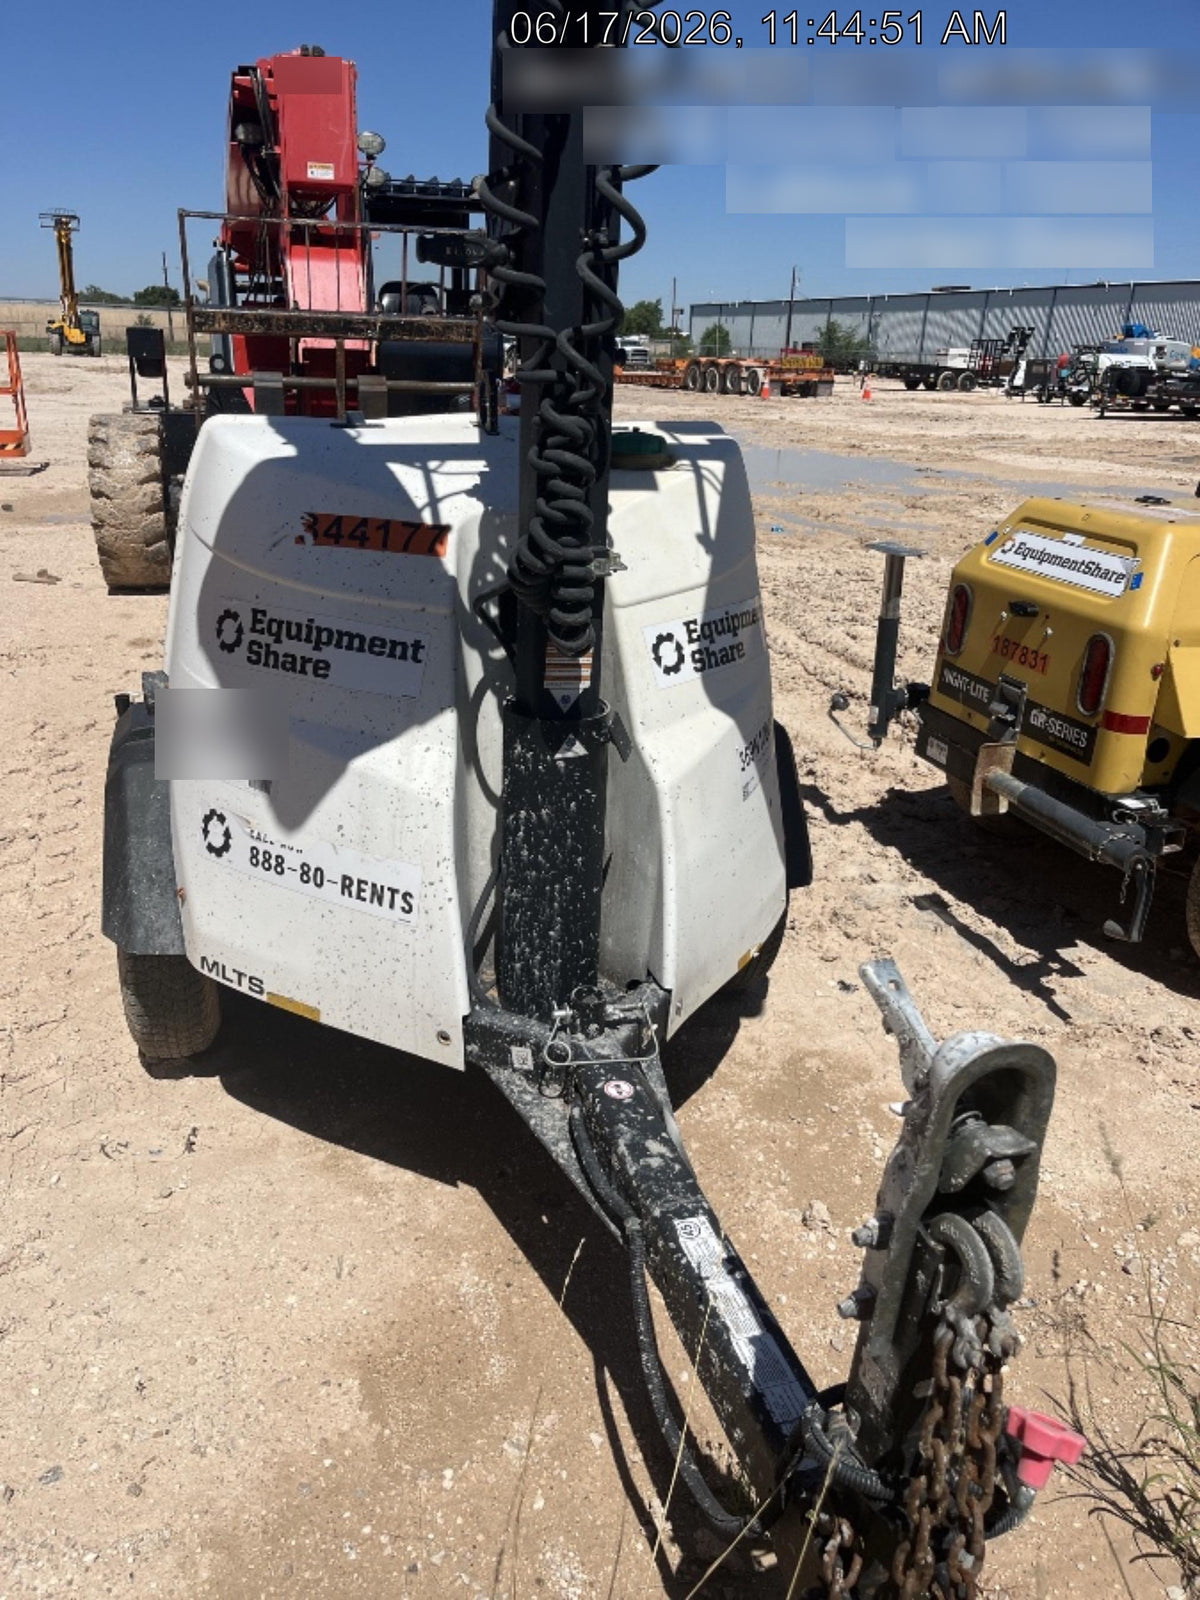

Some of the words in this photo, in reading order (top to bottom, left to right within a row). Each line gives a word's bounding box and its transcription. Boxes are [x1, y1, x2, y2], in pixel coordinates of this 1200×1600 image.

[1014, 541, 1127, 584] EquipmentShare
[250, 608, 425, 664] Equipment
[992, 635, 1049, 675] 187831
[246, 639, 332, 680] Share
[690, 641, 747, 673] Share
[249, 845, 415, 916] 888-80-RENTS
[200, 956, 266, 996] MLTS
